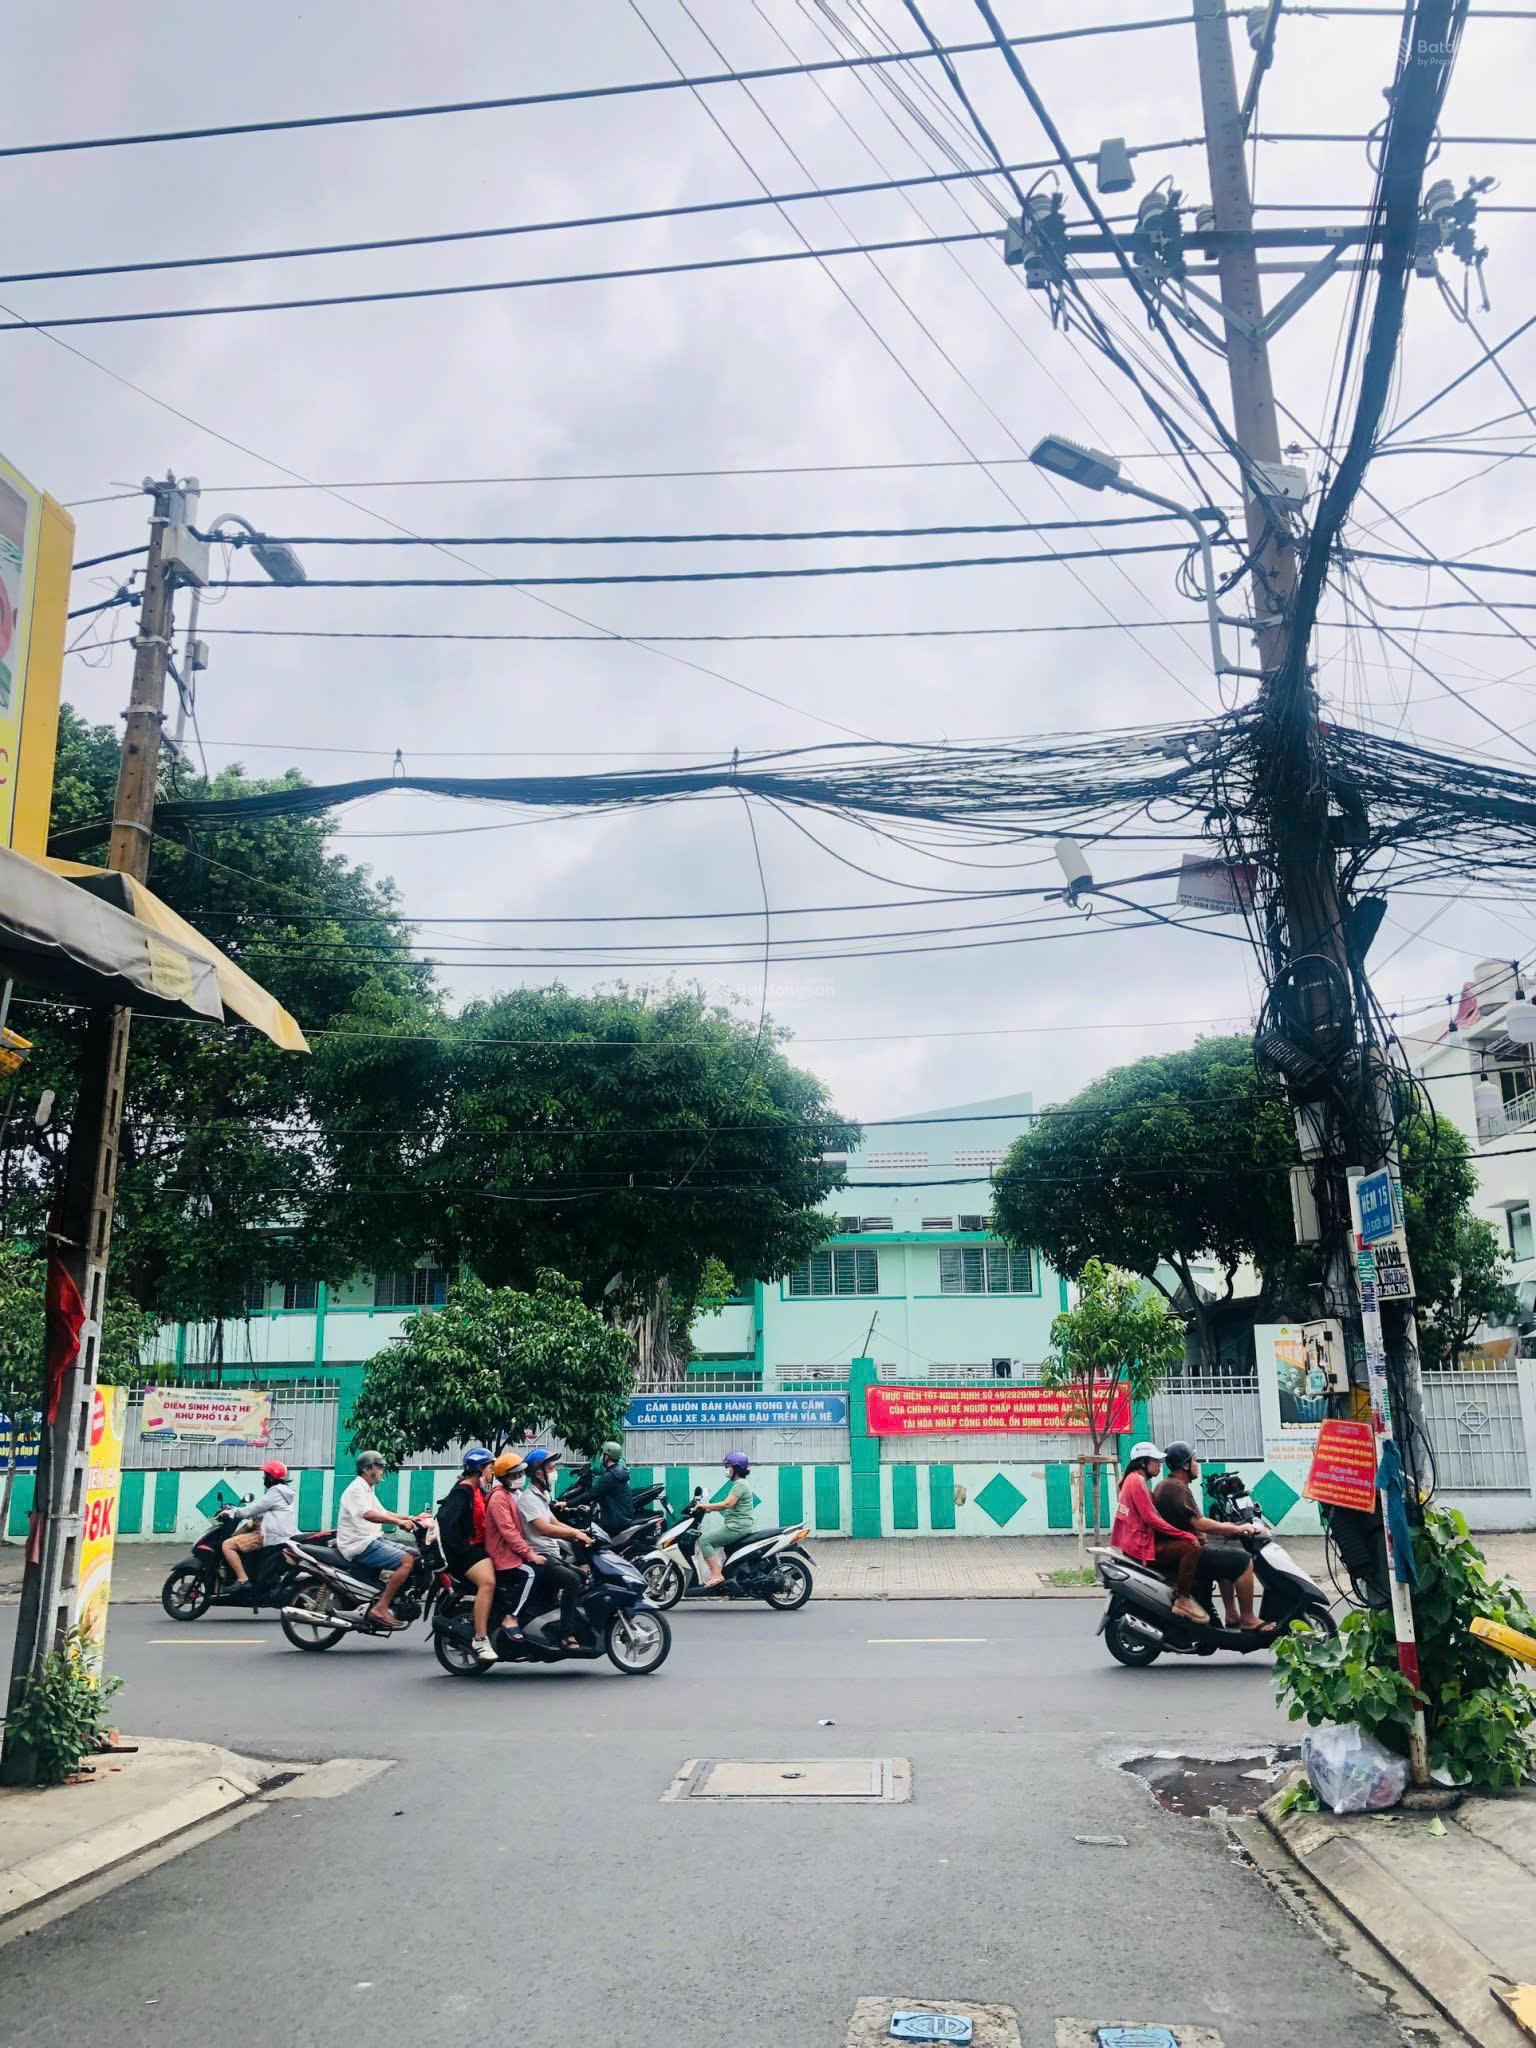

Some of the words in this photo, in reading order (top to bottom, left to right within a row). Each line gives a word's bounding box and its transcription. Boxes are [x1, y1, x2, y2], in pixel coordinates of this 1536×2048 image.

[1378, 1185, 1388, 1207] 15
[188, 1403, 209, 1411] SINH
[671, 1401, 698, 1411] BUÔN
[701, 1400, 722, 1411] BÁN
[725, 1400, 753, 1410] HÀNG
[755, 1401, 783, 1410] RONG
[785, 1400, 798, 1410] VÀ
[907, 1403, 931, 1414] CHÍNH
[1013, 1401, 1036, 1413] HÀNH
[1038, 1403, 1059, 1412] XONG
[223, 1413, 230, 1421] &
[637, 1413, 657, 1423] CÁC
[660, 1414, 683, 1425] LOẠI
[685, 1414, 698, 1422] XE
[701, 1414, 716, 1423] 3,4
[719, 1412, 746, 1422] BÁNH
[772, 1411, 798, 1421] TRÊN
[820, 1410, 833, 1421] HÈ
[903, 1418, 915, 1429] TÁI
